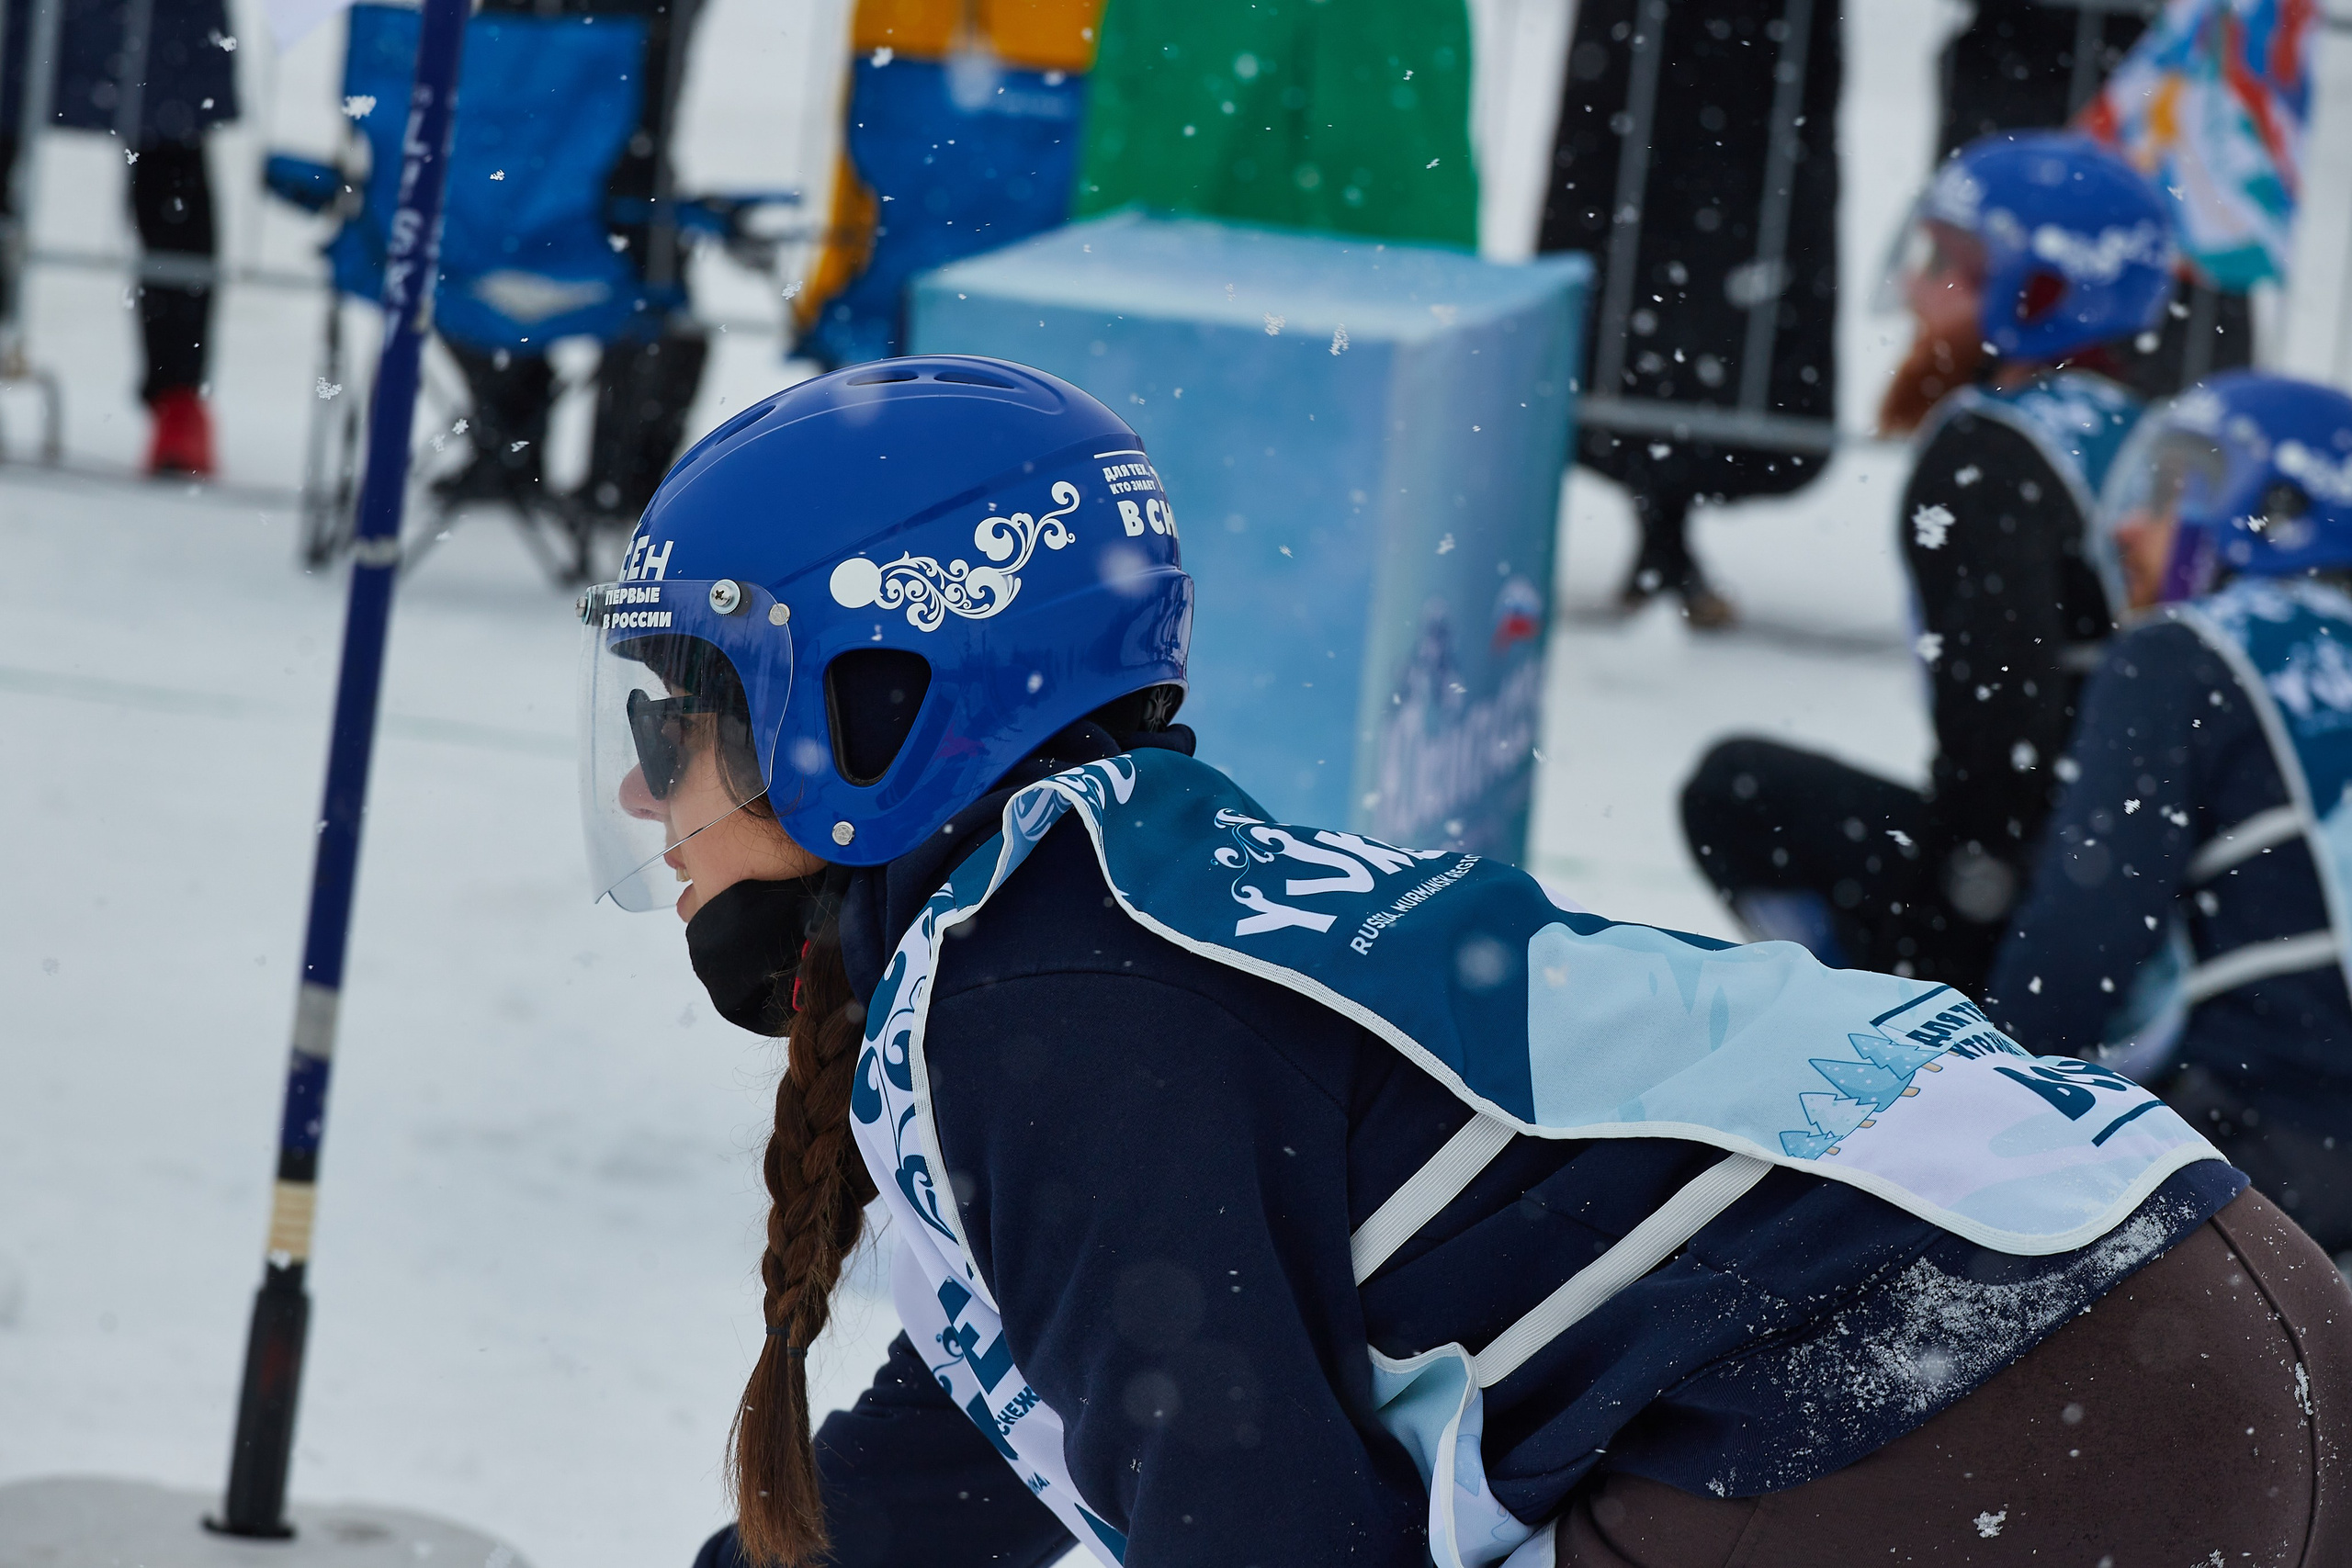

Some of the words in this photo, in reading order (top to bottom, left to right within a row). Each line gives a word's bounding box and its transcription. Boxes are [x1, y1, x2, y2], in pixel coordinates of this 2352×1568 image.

[1102, 464, 1131, 482] ДЛЯ
[1109, 481, 1132, 495] КТО
[1130, 479, 1157, 491] ЗНАЕТ
[1117, 500, 1145, 537] В
[605, 587, 661, 606] ПЕРВЫЕ
[603, 614, 611, 630] В
[611, 611, 673, 629] РОССИИ
[1350, 910, 1406, 956] RUSSIA,
[1390, 874, 1452, 912] MURMANSK
[1905, 1011, 1973, 1048] ДЛЯ
[1949, 1034, 1996, 1061] КТО
